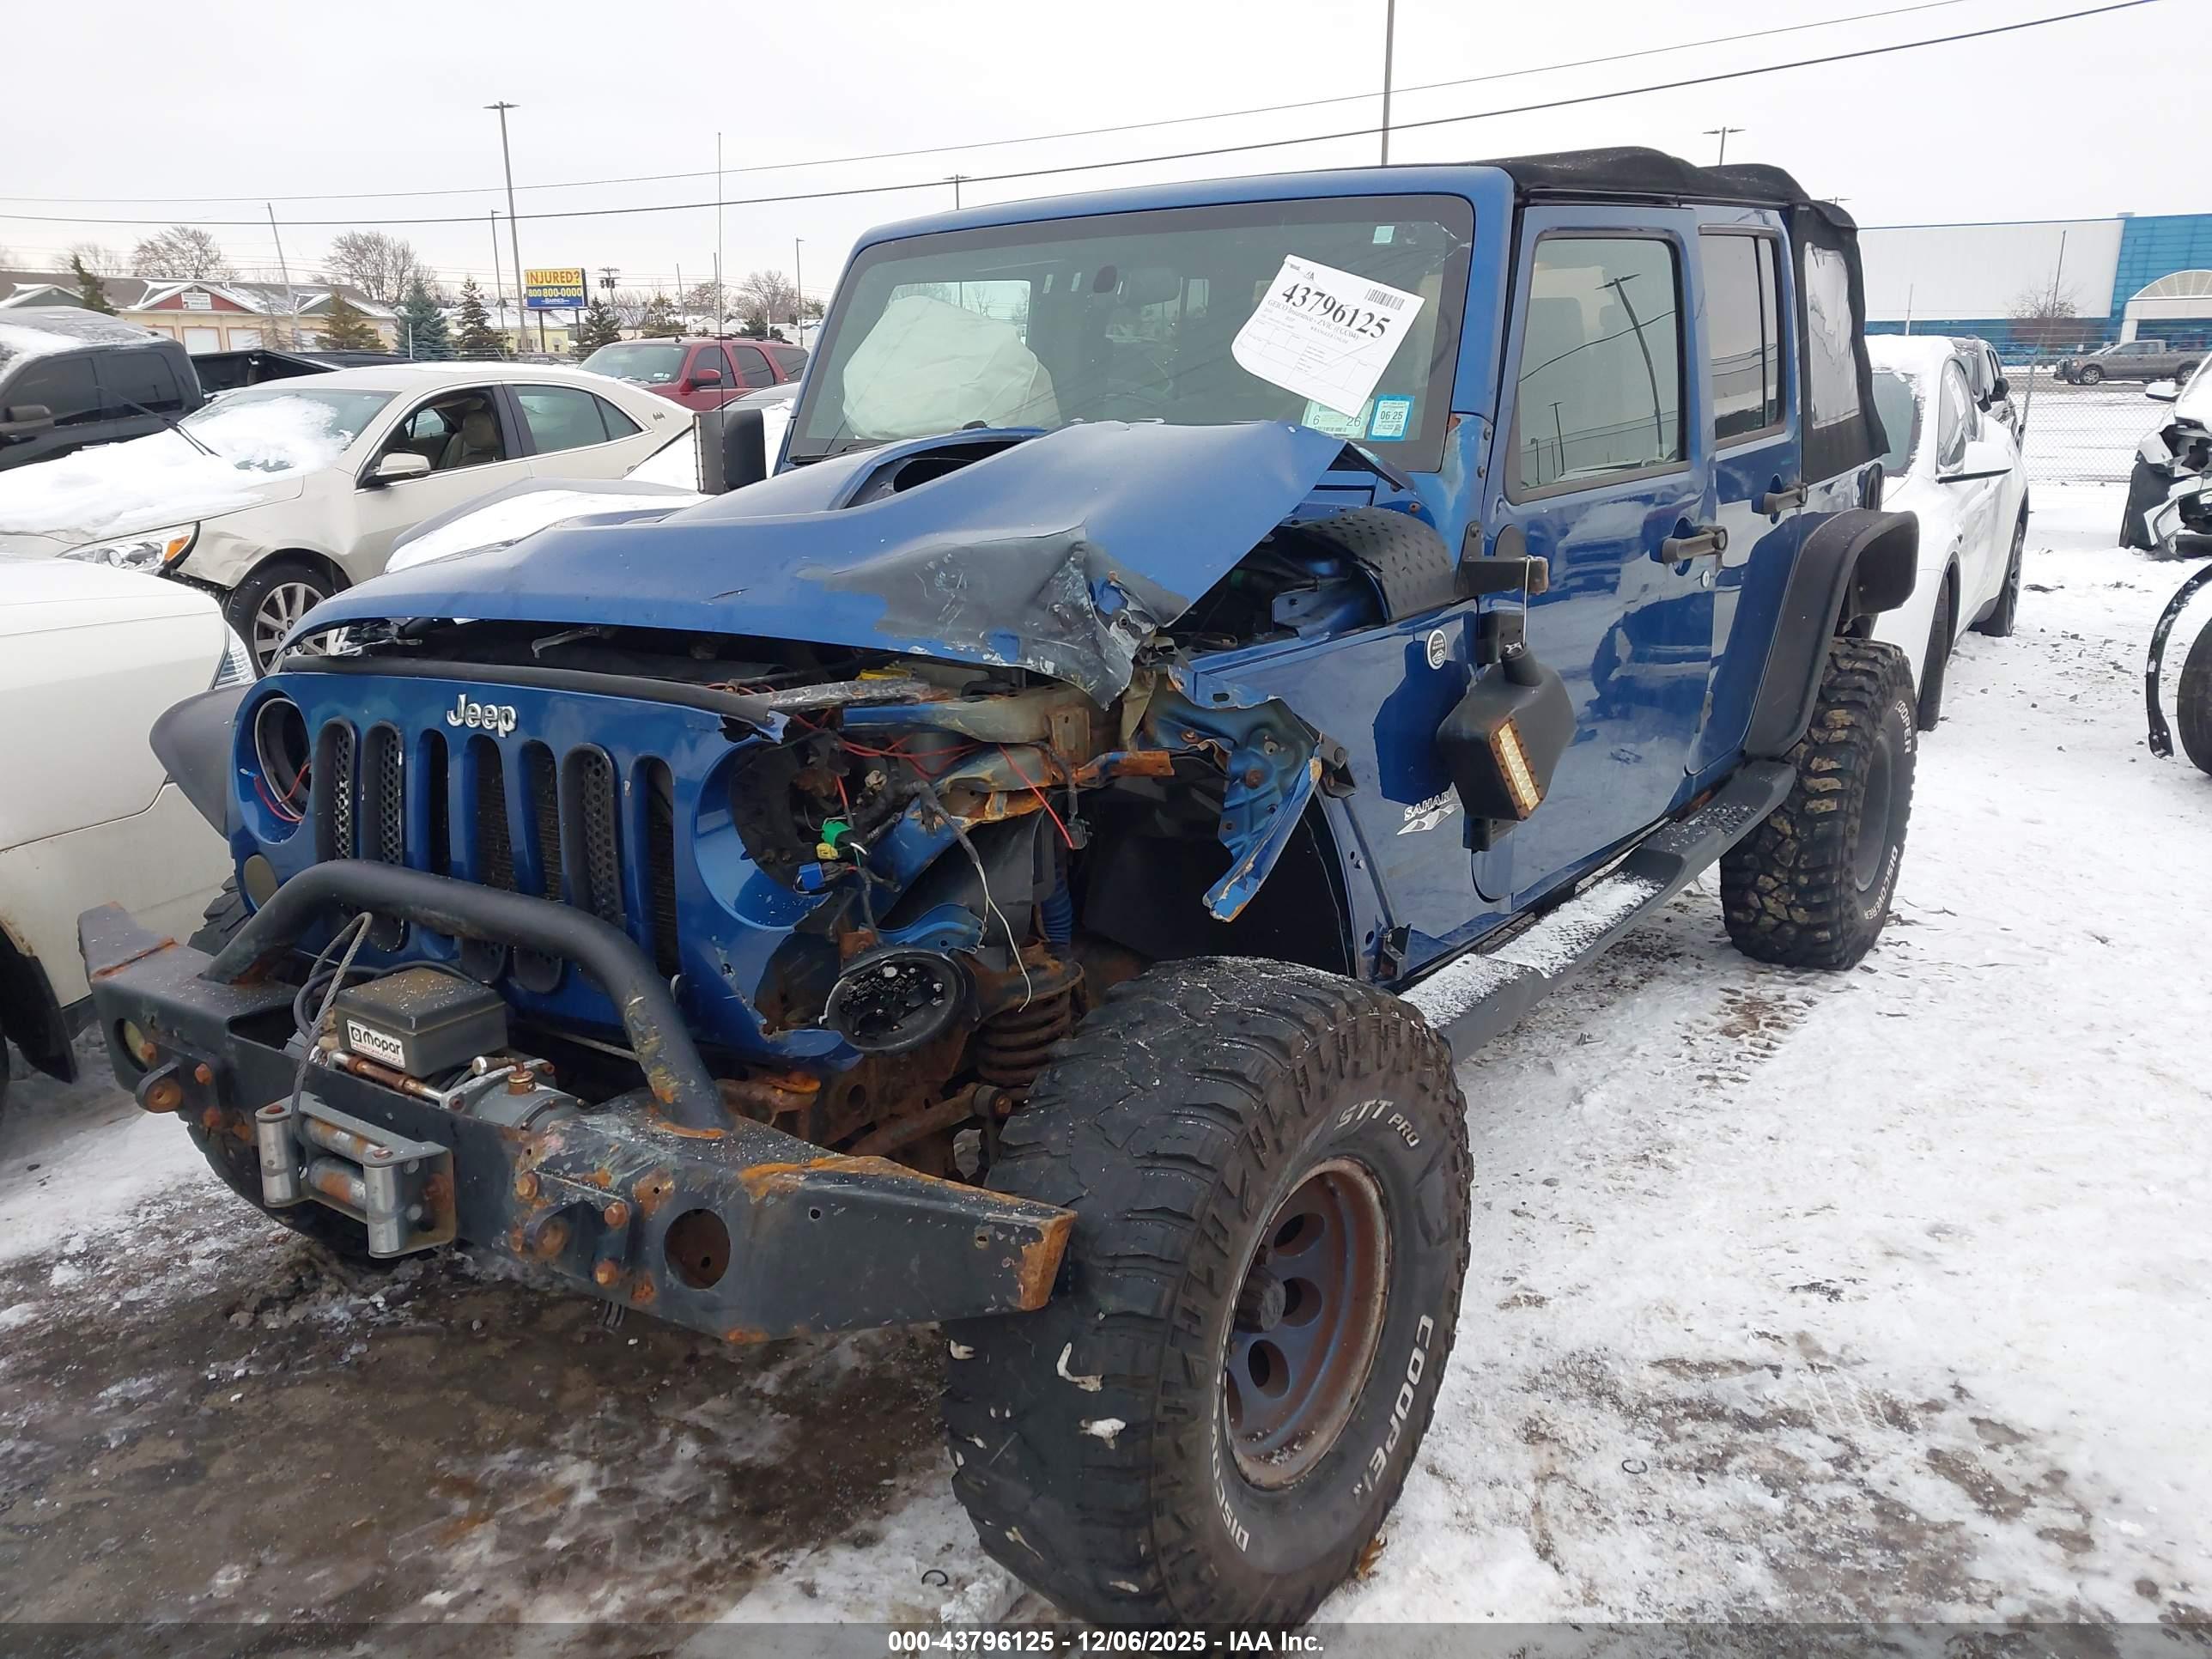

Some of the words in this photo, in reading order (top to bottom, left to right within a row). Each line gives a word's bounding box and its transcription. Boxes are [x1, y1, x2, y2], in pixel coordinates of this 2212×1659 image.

[526, 270, 580, 284] INJURED?
[528, 289, 542, 297] 800
[543, 287, 582, 298] 800-0000
[1267, 300, 1288, 312] GEICO
[1281, 283, 1392, 338] 43796125
[1312, 415, 1321, 425] 6
[1346, 416, 1361, 427] 26
[447, 693, 517, 738] Jeep
[1894, 700, 1912, 754] COOPER
[1404, 791, 1452, 822] SAHAR
[1334, 1099, 1394, 1131] STT
[1388, 1112, 1420, 1147] PRO
